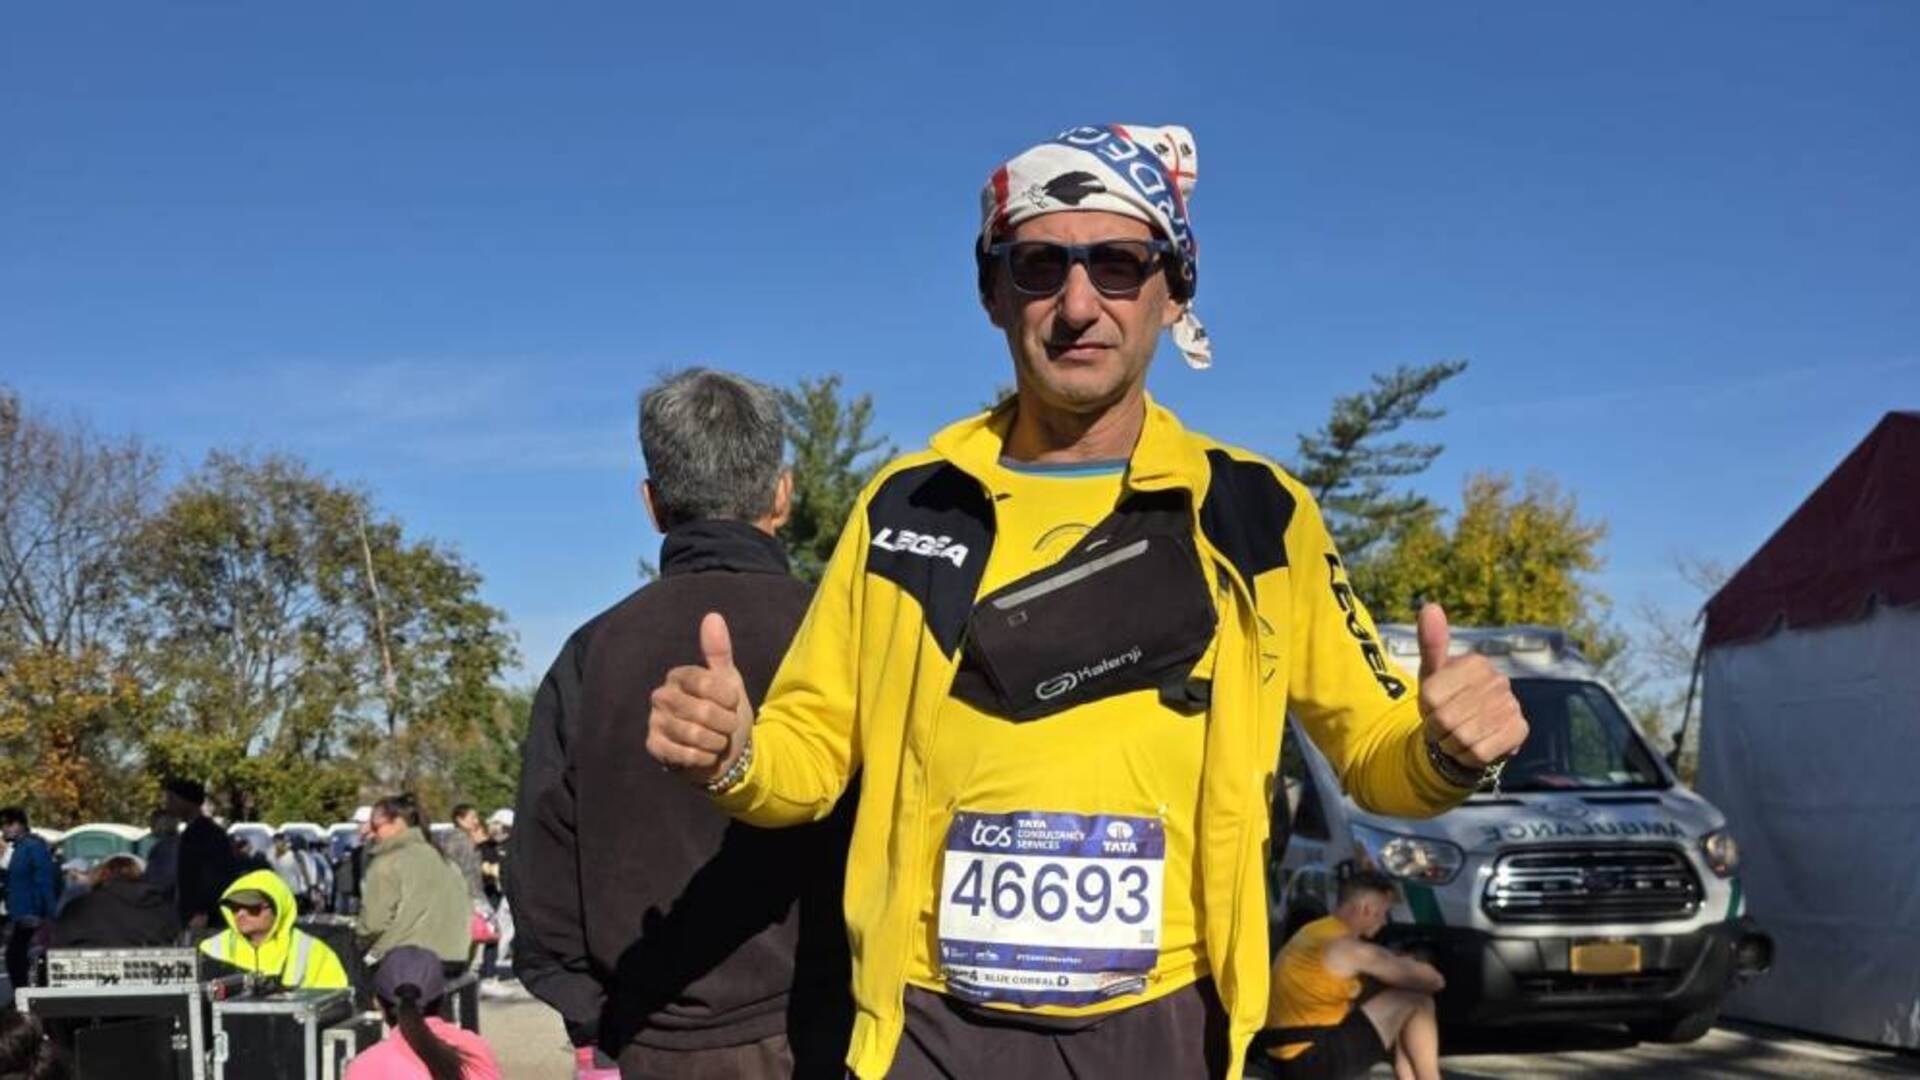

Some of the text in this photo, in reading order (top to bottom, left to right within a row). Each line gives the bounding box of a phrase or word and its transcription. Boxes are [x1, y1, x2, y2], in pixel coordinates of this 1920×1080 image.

[1077, 645, 1142, 682] Kalenji
[1018, 819, 1047, 828] TATA
[971, 819, 1012, 848] tcs
[1017, 829, 1086, 842] CONSULTANCY
[1016, 840, 1061, 850] SERVICES
[1103, 840, 1138, 854] TATA
[950, 858, 1151, 924] 46693
[984, 973, 1011, 983] BLUE
